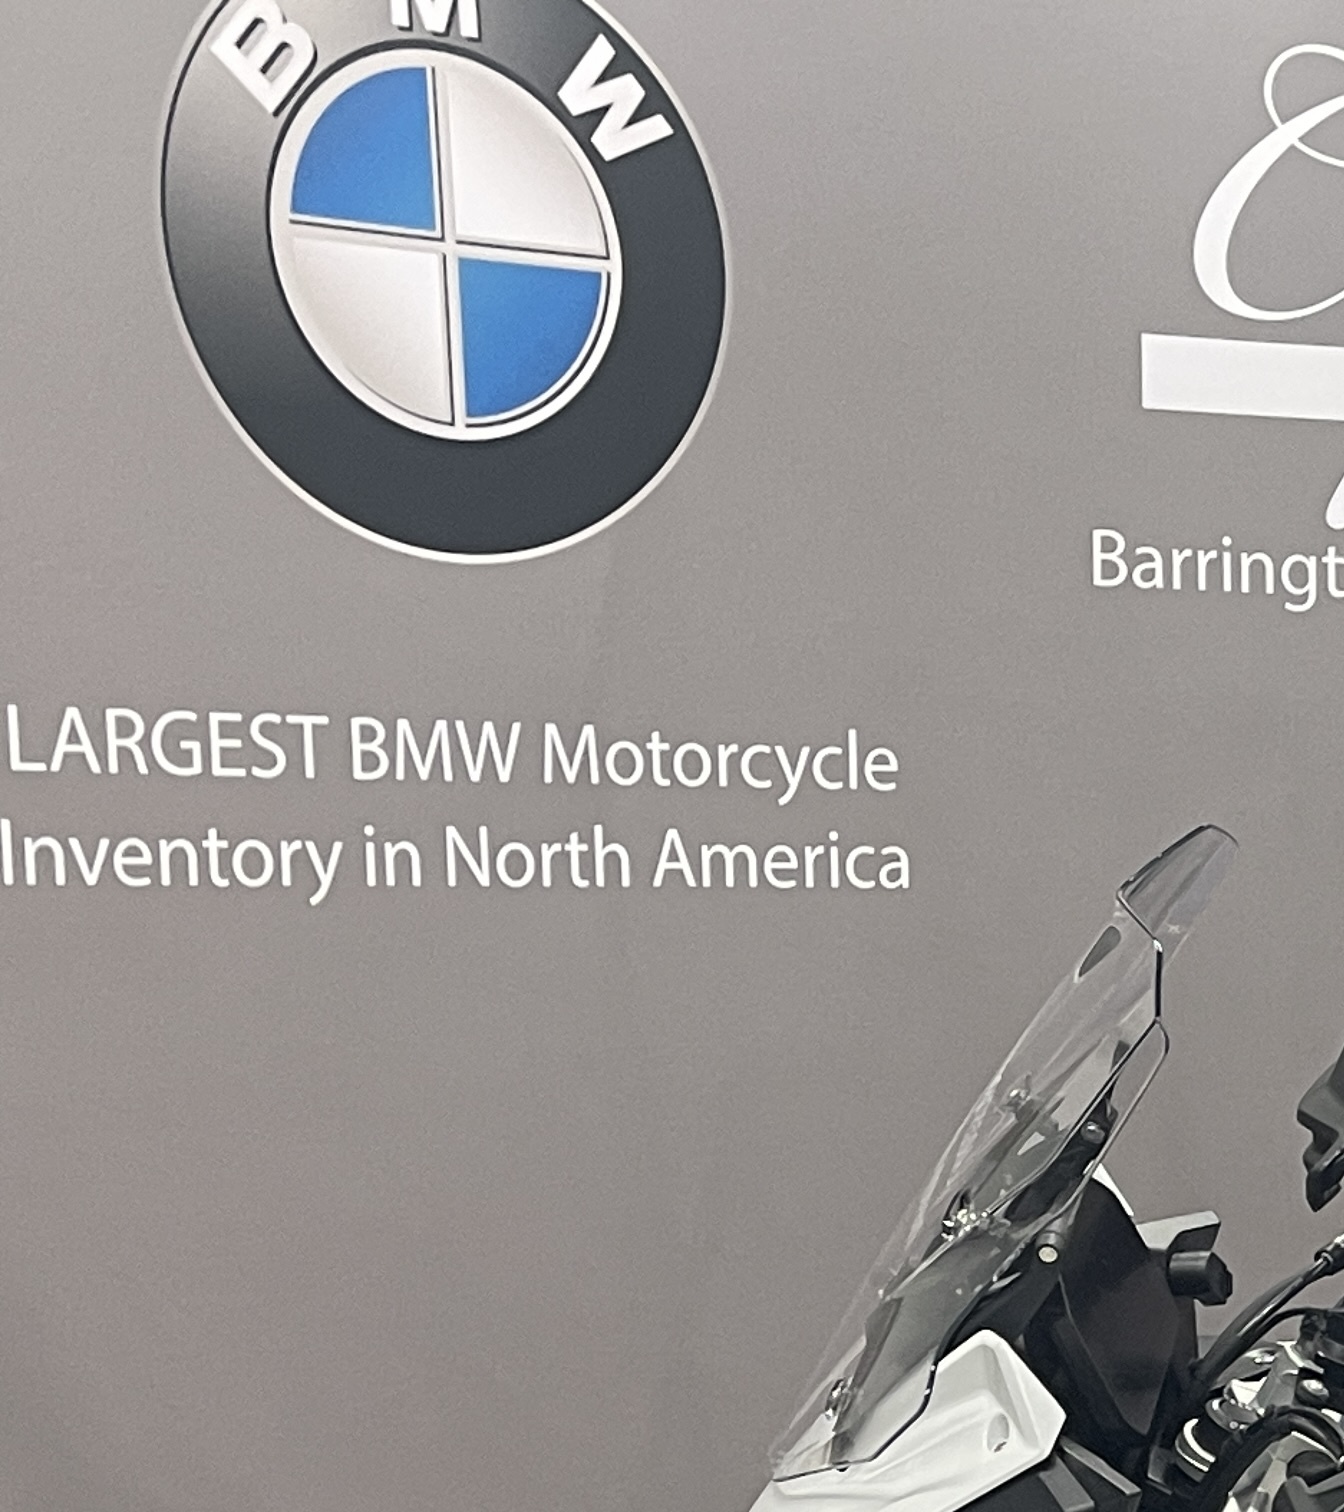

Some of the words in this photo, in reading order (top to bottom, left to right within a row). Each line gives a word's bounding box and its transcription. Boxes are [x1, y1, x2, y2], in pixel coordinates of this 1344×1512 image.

[6, 703, 330, 779] LARGEST
[350, 716, 522, 783] BMW
[543, 722, 900, 806] Motorcycle
[0, 818, 343, 906] Inventory
[363, 824, 423, 887] in
[445, 824, 631, 888] North
[652, 828, 911, 889] America
